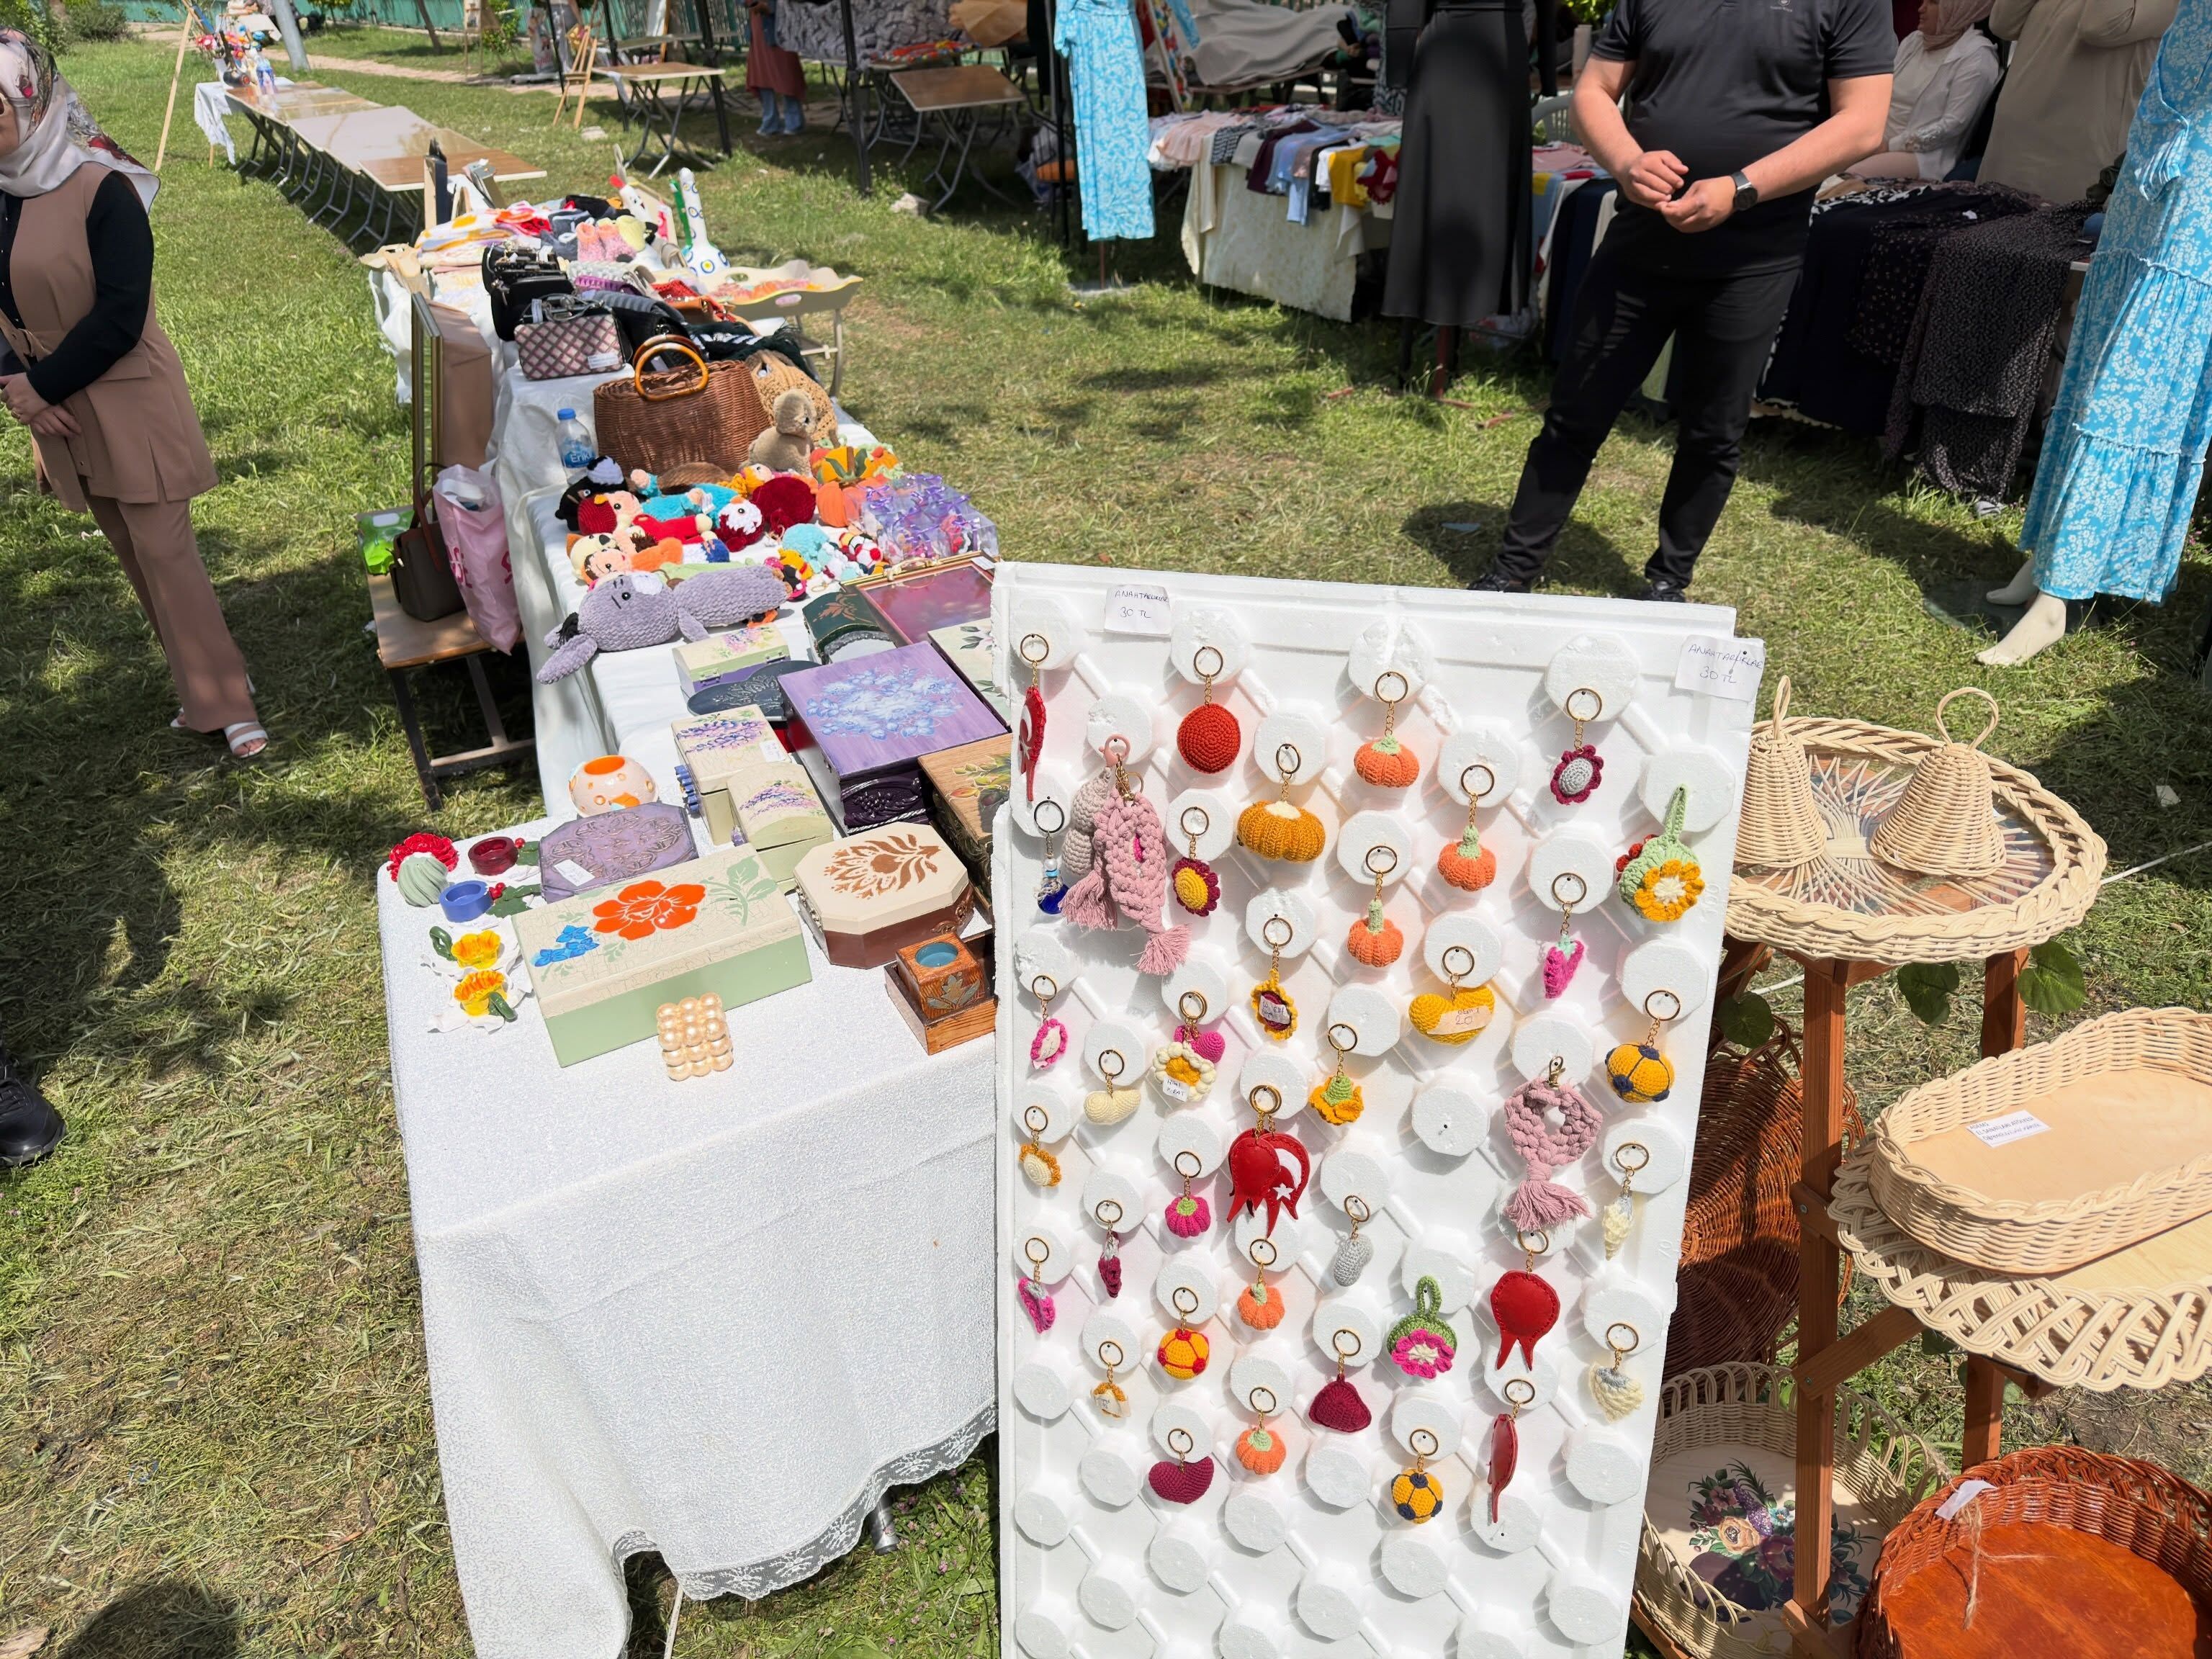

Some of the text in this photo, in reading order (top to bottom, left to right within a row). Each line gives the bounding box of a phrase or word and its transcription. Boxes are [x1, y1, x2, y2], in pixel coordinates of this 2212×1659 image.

[1120, 606, 1133, 618] 30
[1699, 666, 1737, 683] 30 TL
